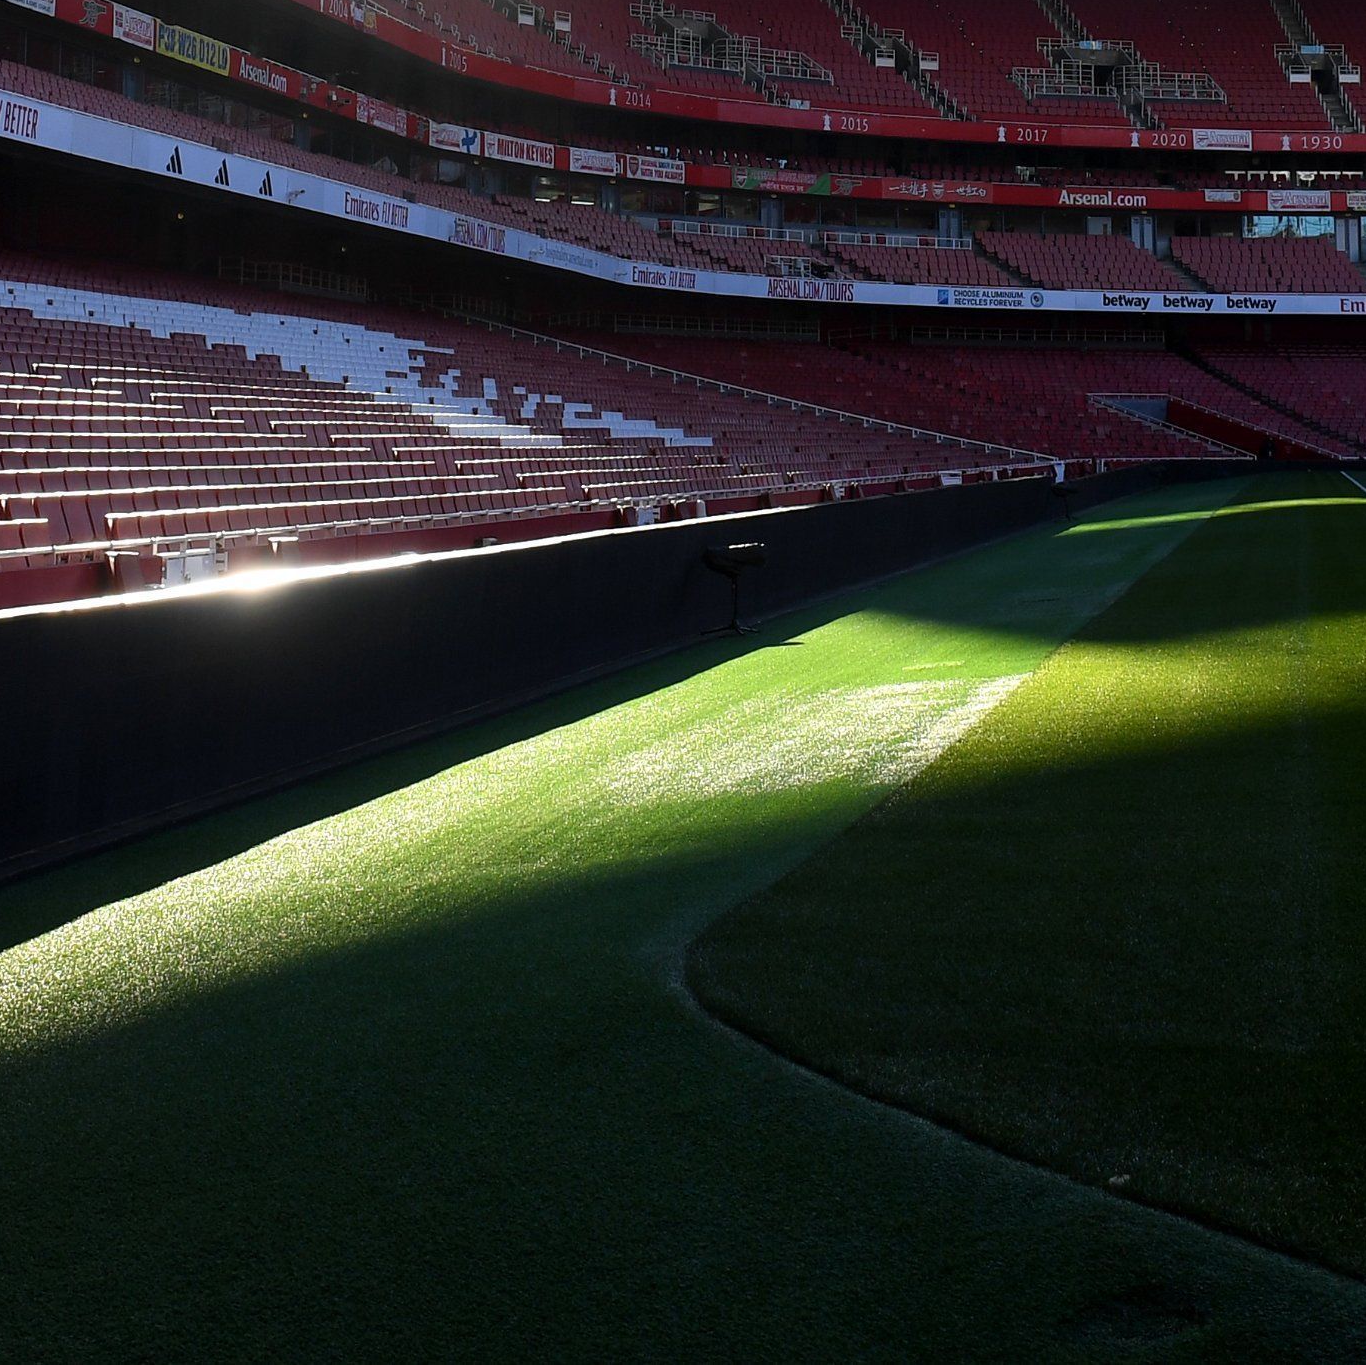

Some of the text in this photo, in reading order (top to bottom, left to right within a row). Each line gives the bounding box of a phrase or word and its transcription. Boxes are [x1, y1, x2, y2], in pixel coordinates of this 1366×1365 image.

[239, 57, 287, 93] Arsenal.com
[625, 91, 651, 108] 2014
[4, 102, 39, 139] BETTER
[841, 116, 869, 132] 2015
[1016, 128, 1048, 142] 2017
[1152, 134, 1186, 147] 2020
[1301, 136, 1342, 149] 1930
[497, 138, 553, 165] MILTON KEYNES
[1058, 189, 1147, 206] Arsenal.com
[344, 192, 379, 222] Emirates
[632, 266, 696, 289] Emirates FLY BETTER
[768, 279, 854, 301] ARSENAL.COM/TOURS
[954, 290, 1025, 299] CHOOSE ALUMINIUM.
[954, 297, 1024, 307] RECYCLES FOREVER.
[1103, 294, 1150, 310] betway
[1163, 295, 1214, 311] betway
[1226, 296, 1276, 312] betway
